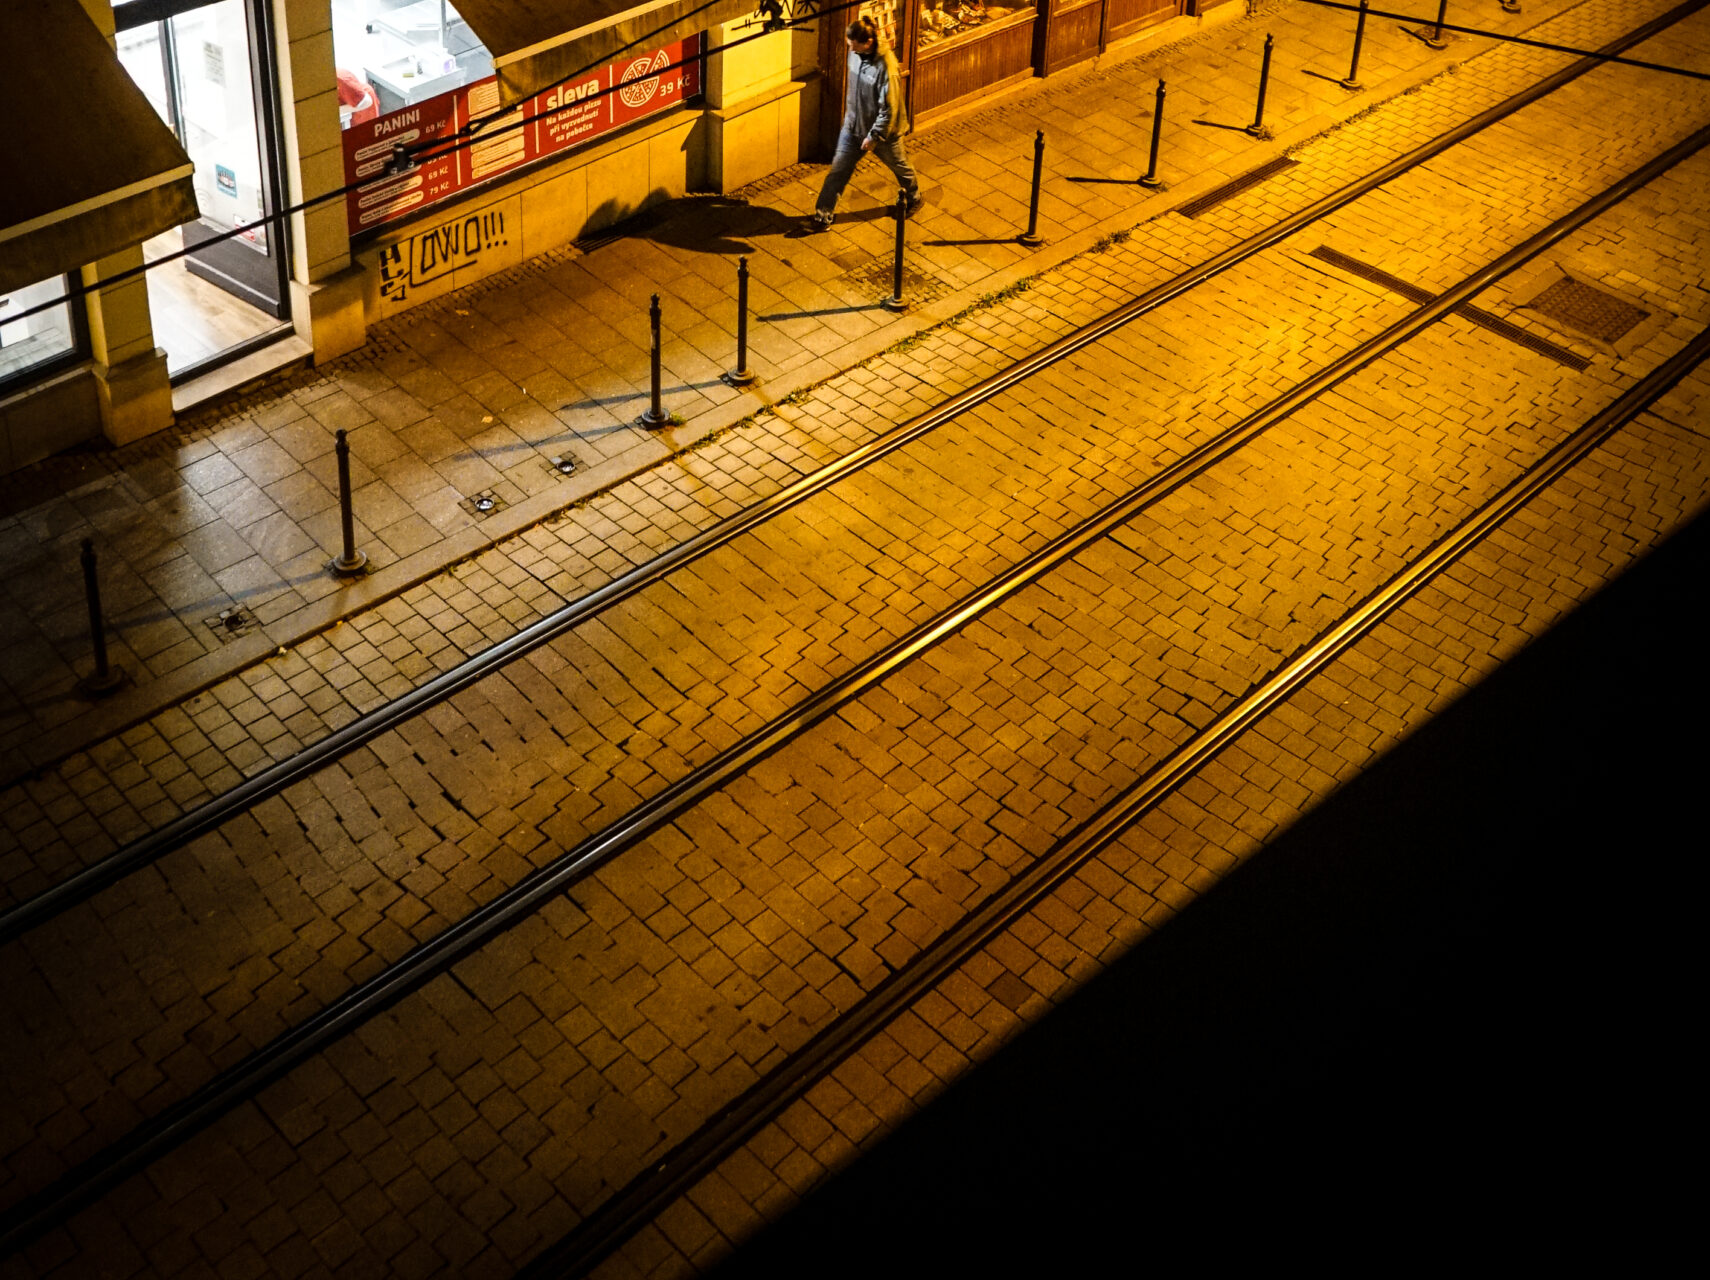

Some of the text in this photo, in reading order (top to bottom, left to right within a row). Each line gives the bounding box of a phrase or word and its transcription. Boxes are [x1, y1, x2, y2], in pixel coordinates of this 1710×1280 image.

[659, 73, 691, 97] 39 Kč
[546, 79, 600, 111] sleva
[558, 107, 583, 121] každou
[374, 108, 420, 137] PANINI
[425, 119, 446, 134] 69 Kč
[439, 165, 448, 176] Kč
[440, 181, 449, 192] Kč
